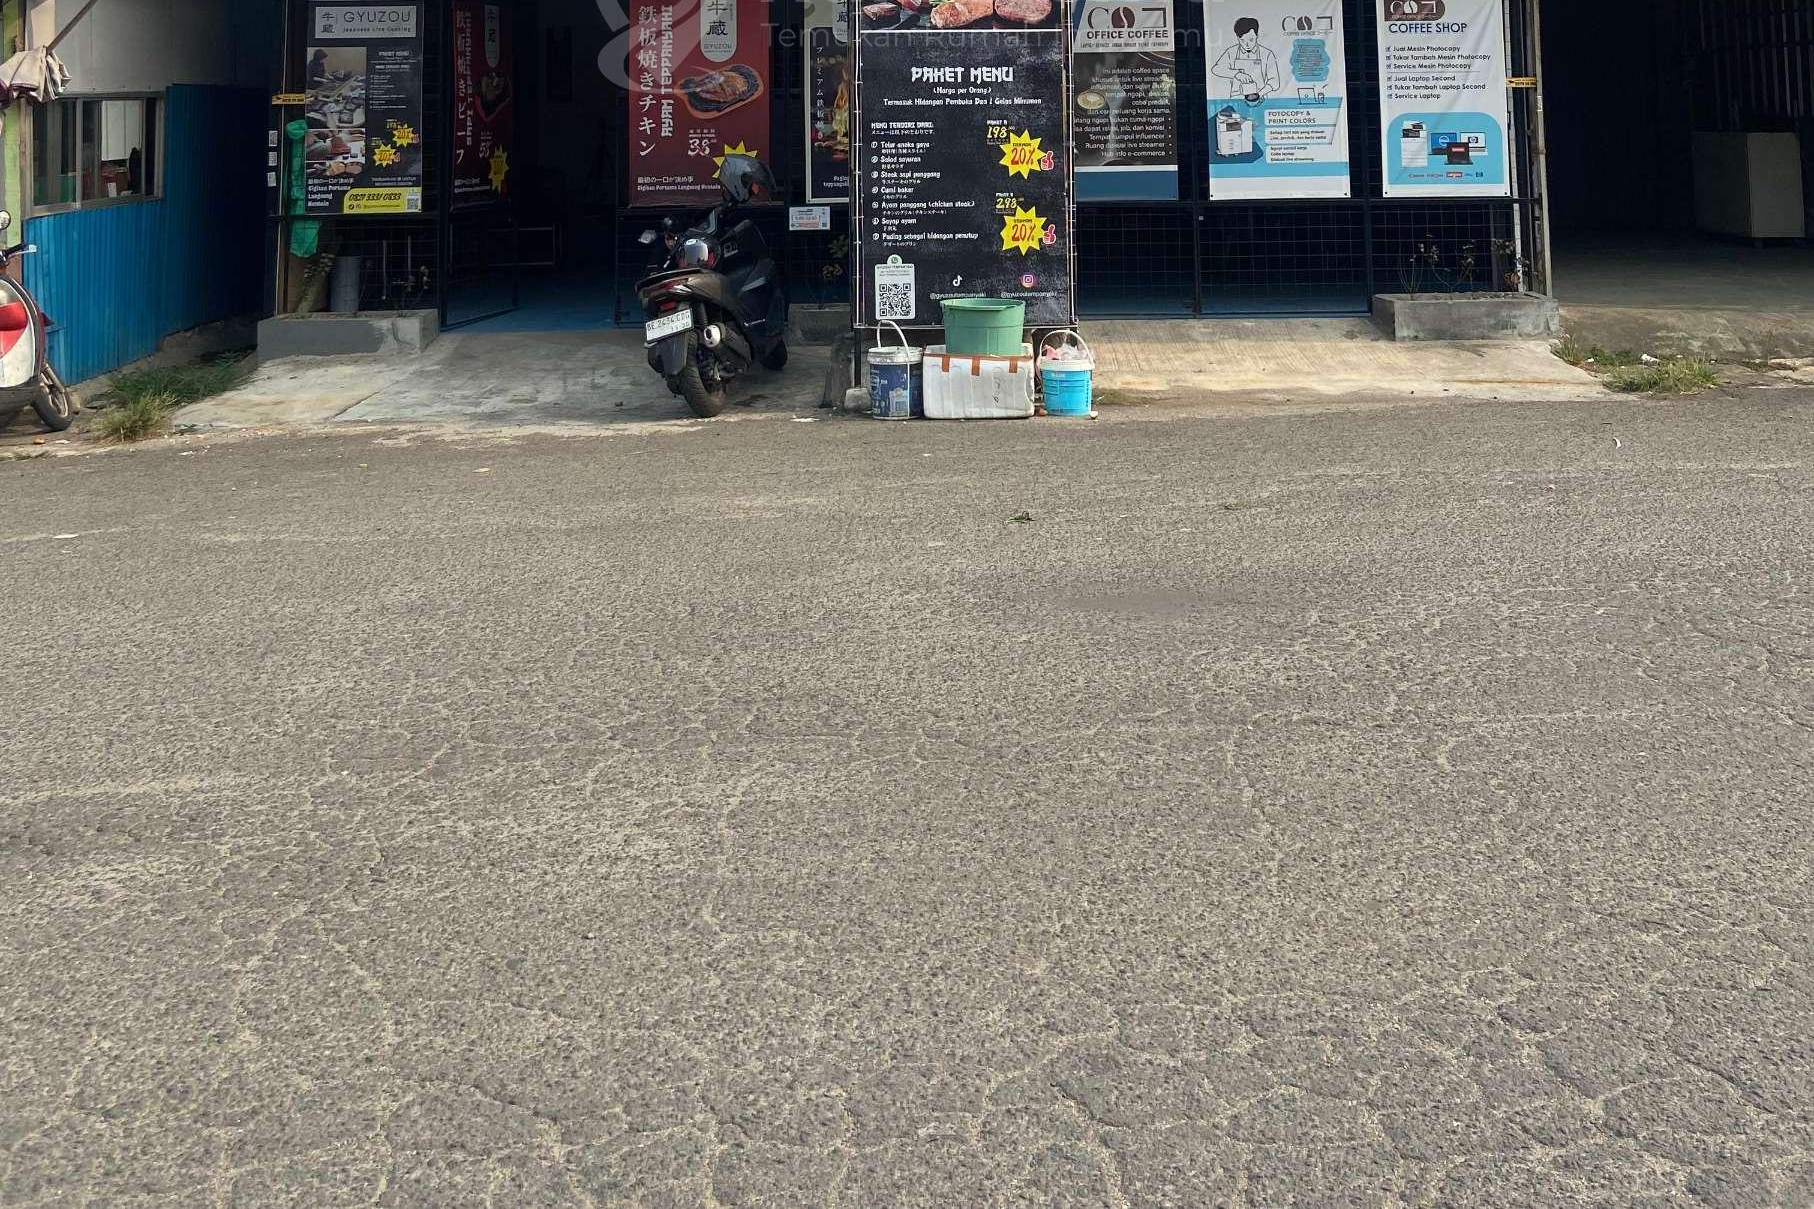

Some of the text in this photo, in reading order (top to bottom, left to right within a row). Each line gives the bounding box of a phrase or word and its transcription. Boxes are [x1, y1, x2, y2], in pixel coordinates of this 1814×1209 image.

[343, 10, 411, 23] GYUZOU
[1388, 22, 1468, 33] COFFEE SHOP
[1086, 30, 1169, 40] OFFICE COFFEE
[1457, 53, 1492, 61] Photocopy
[638, 5, 658, 156] 鉄板焼きチキン
[911, 66, 1014, 85] PAKET MENU
[883, 98, 913, 106] Termasuk
[914, 98, 944, 107] Hidangan
[974, 97, 988, 105] Dan
[994, 97, 1012, 105] Gelas
[986, 126, 1008, 139] 198
[1010, 147, 1036, 166] 20%
[899, 201, 927, 209] panggang
[995, 198, 1017, 209] 298
[954, 232, 979, 240] penutup
[1011, 223, 1037, 242] 20%
